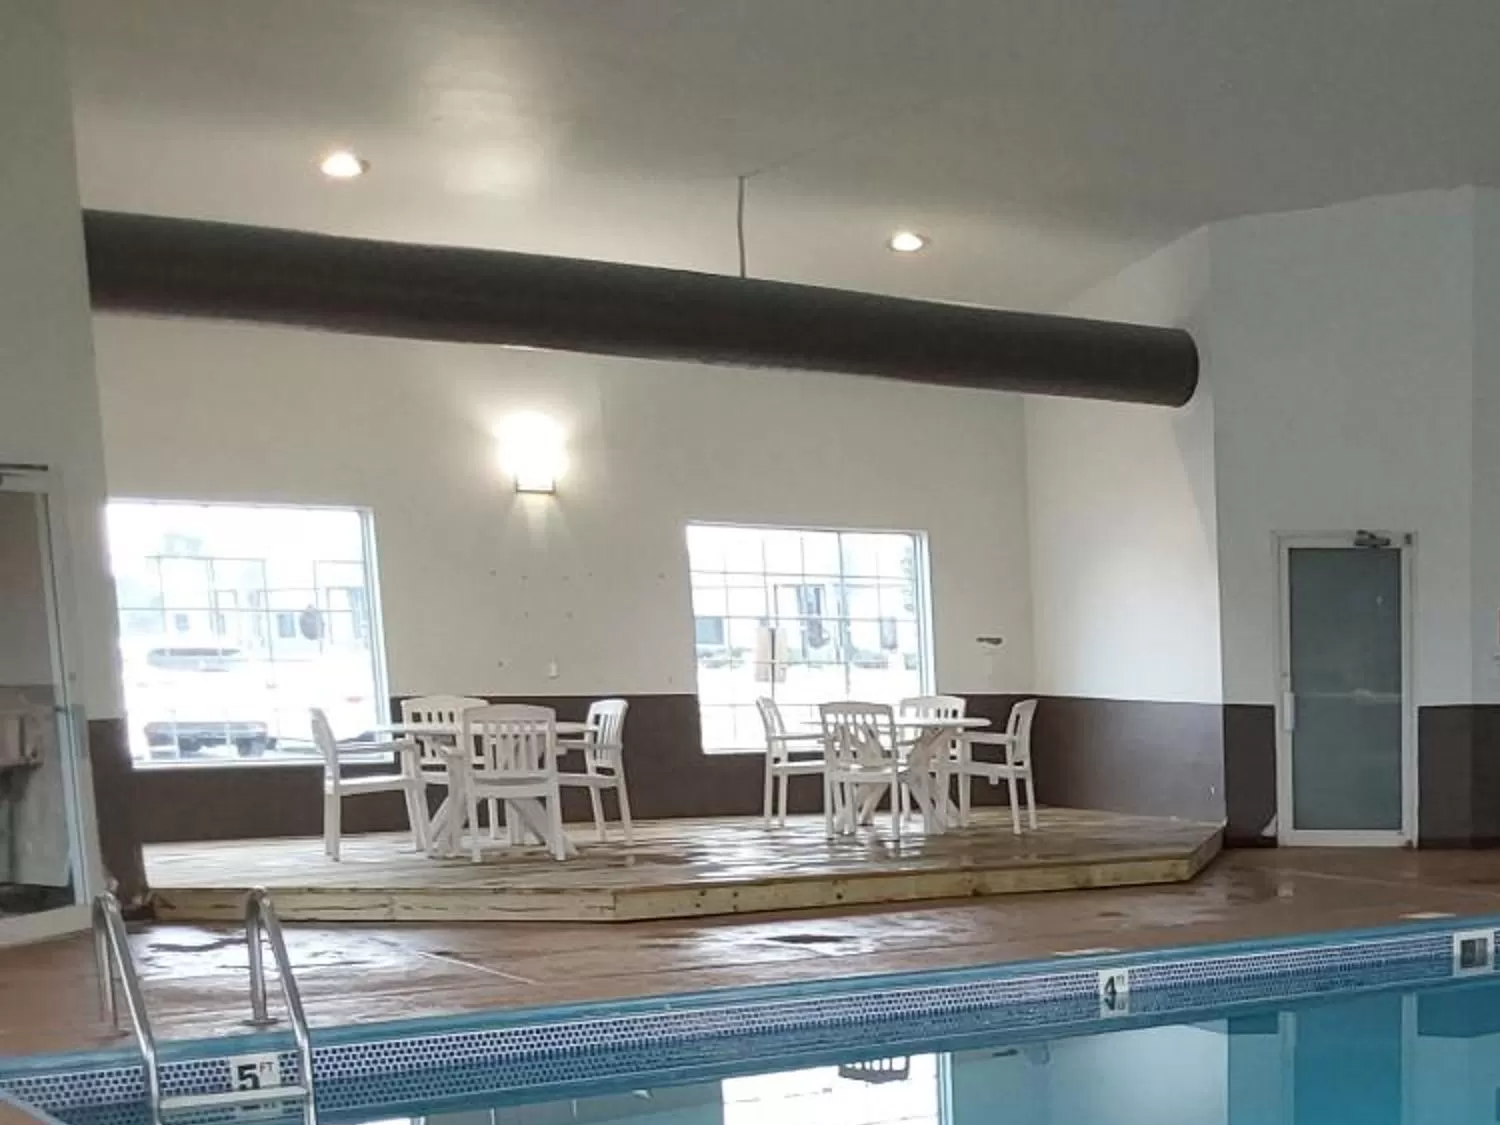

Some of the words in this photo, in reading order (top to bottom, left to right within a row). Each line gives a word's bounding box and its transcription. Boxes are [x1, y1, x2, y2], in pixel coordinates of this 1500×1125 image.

[1104, 976, 1117, 998] 4
[238, 1063, 260, 1090] 5
[259, 1061, 274, 1073] FT
